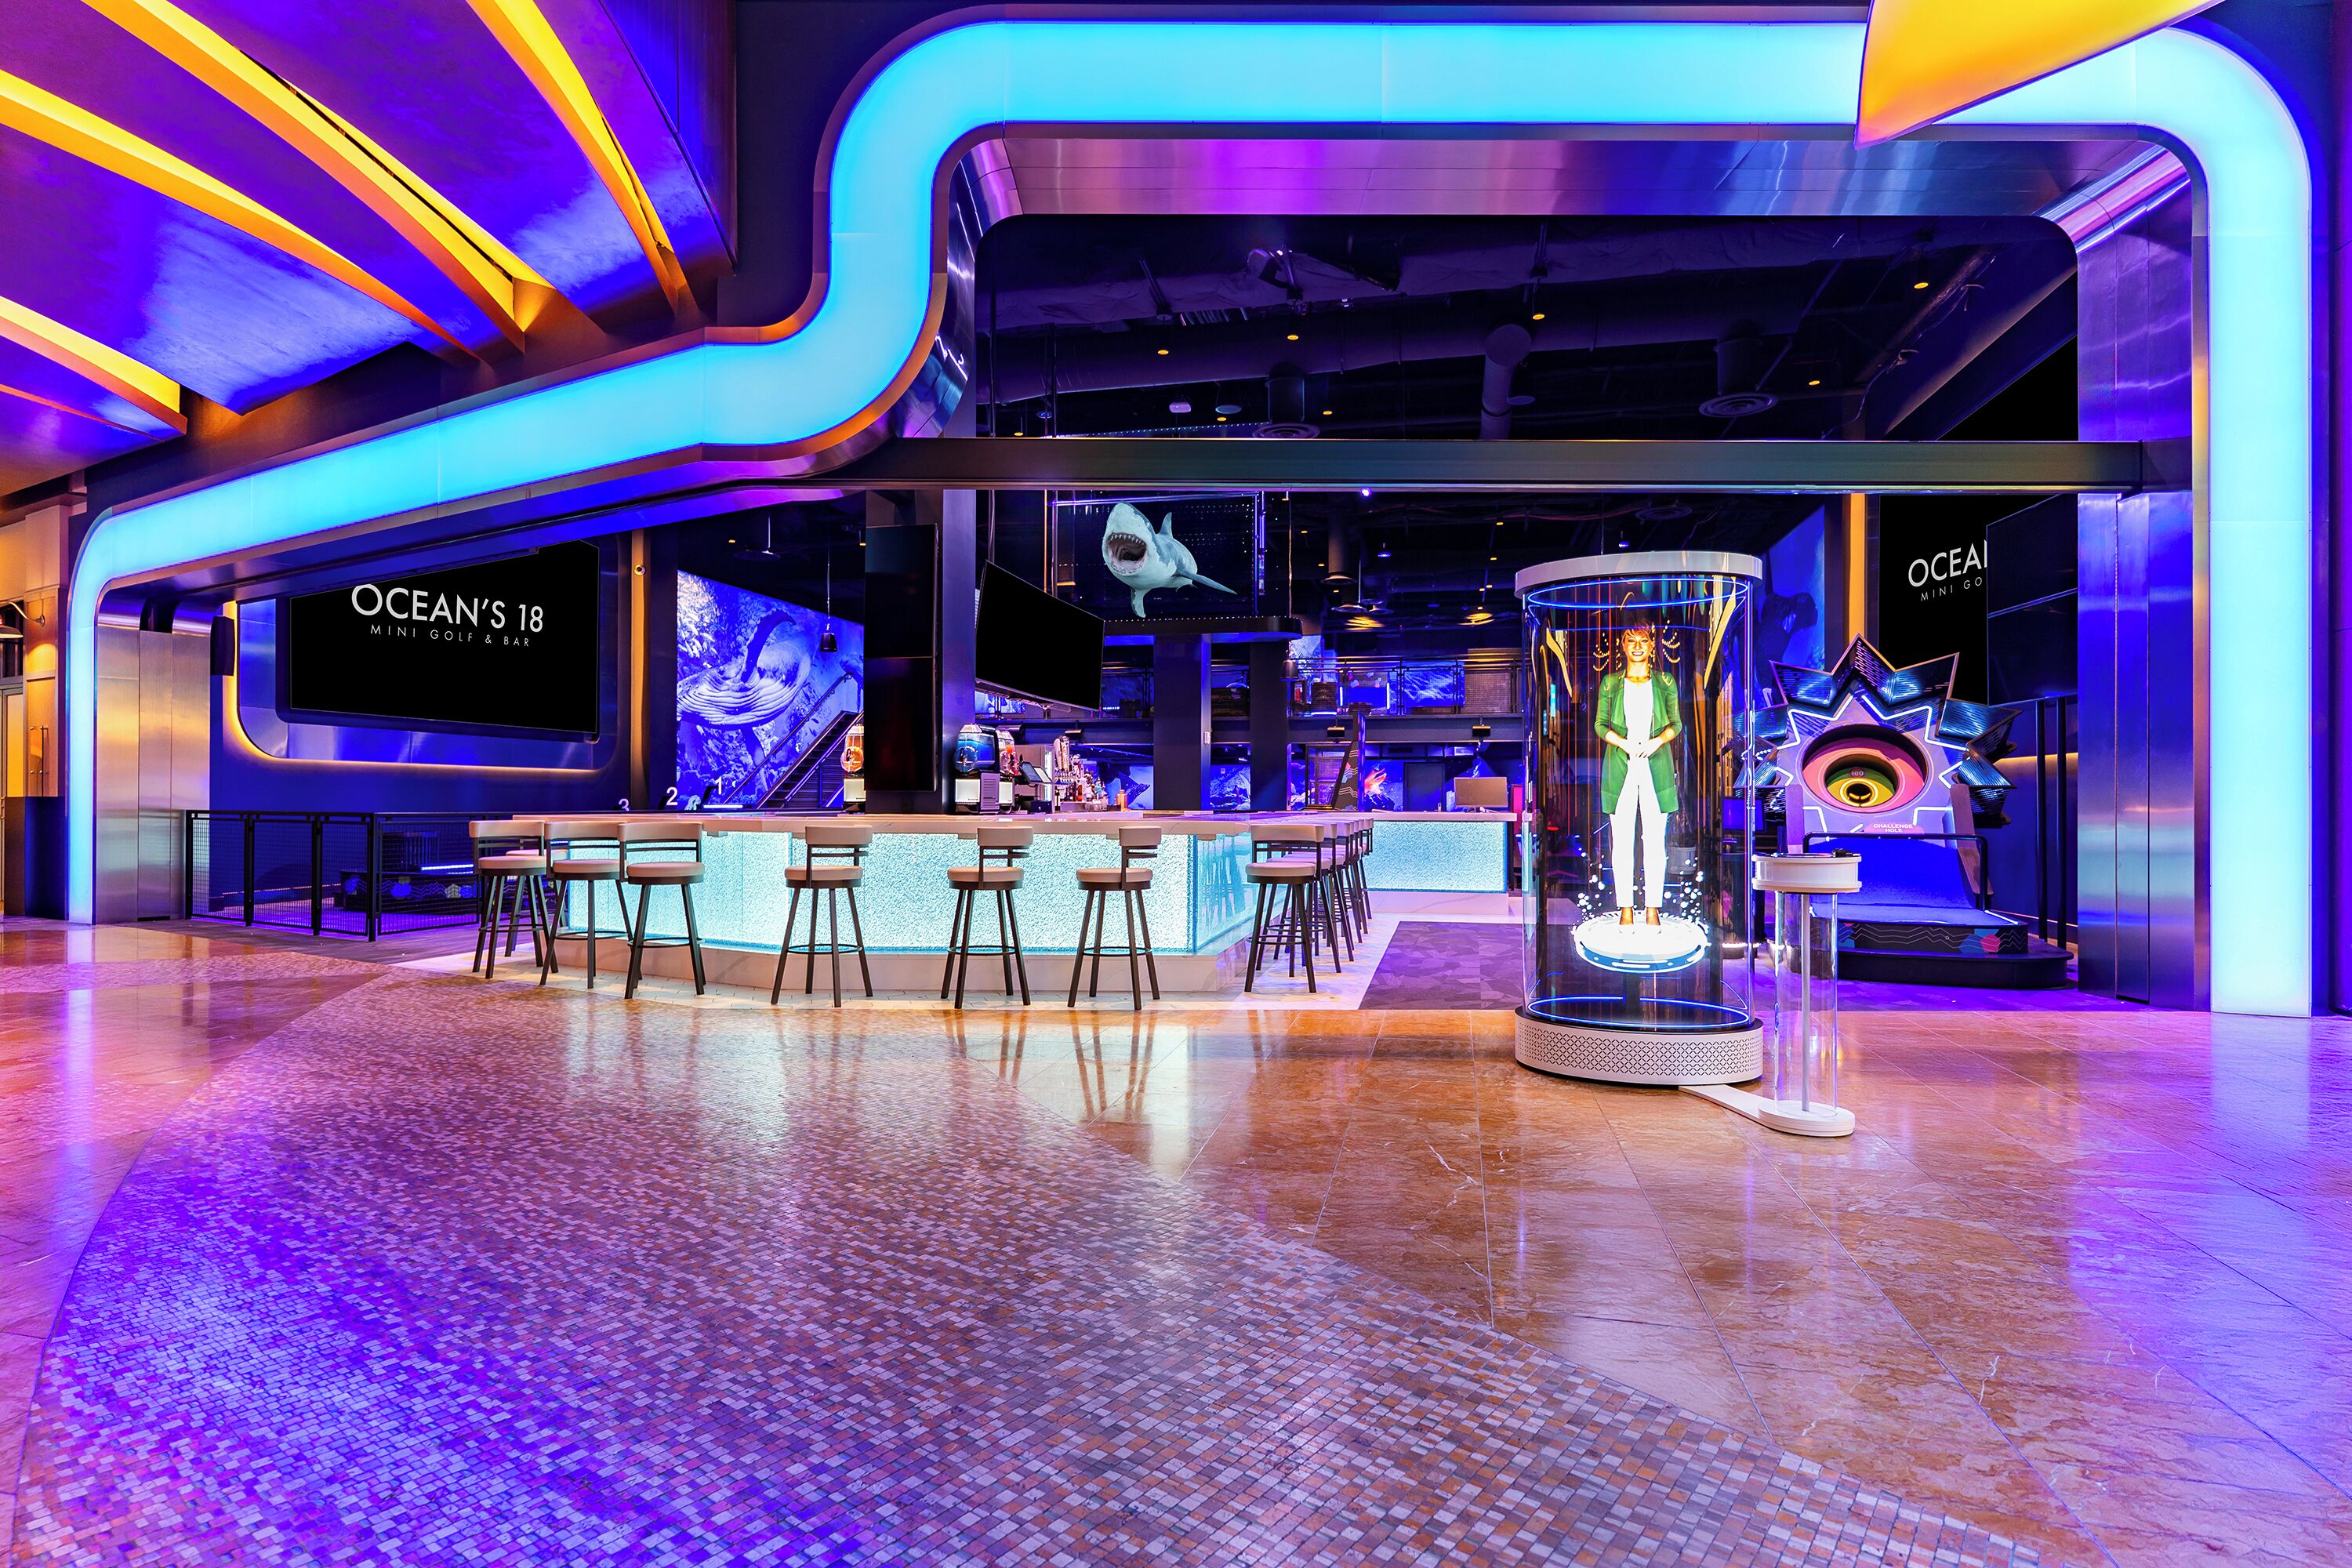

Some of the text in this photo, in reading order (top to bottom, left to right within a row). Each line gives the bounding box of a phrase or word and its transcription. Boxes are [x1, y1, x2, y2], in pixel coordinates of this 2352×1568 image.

[1921, 585, 1953, 601] MINI
[351, 583, 543, 633] OCEAN'S 18
[370, 624, 529, 647] MINI GOLF & BAR
[714, 776, 722, 795] 1
[666, 786, 678, 806] 2
